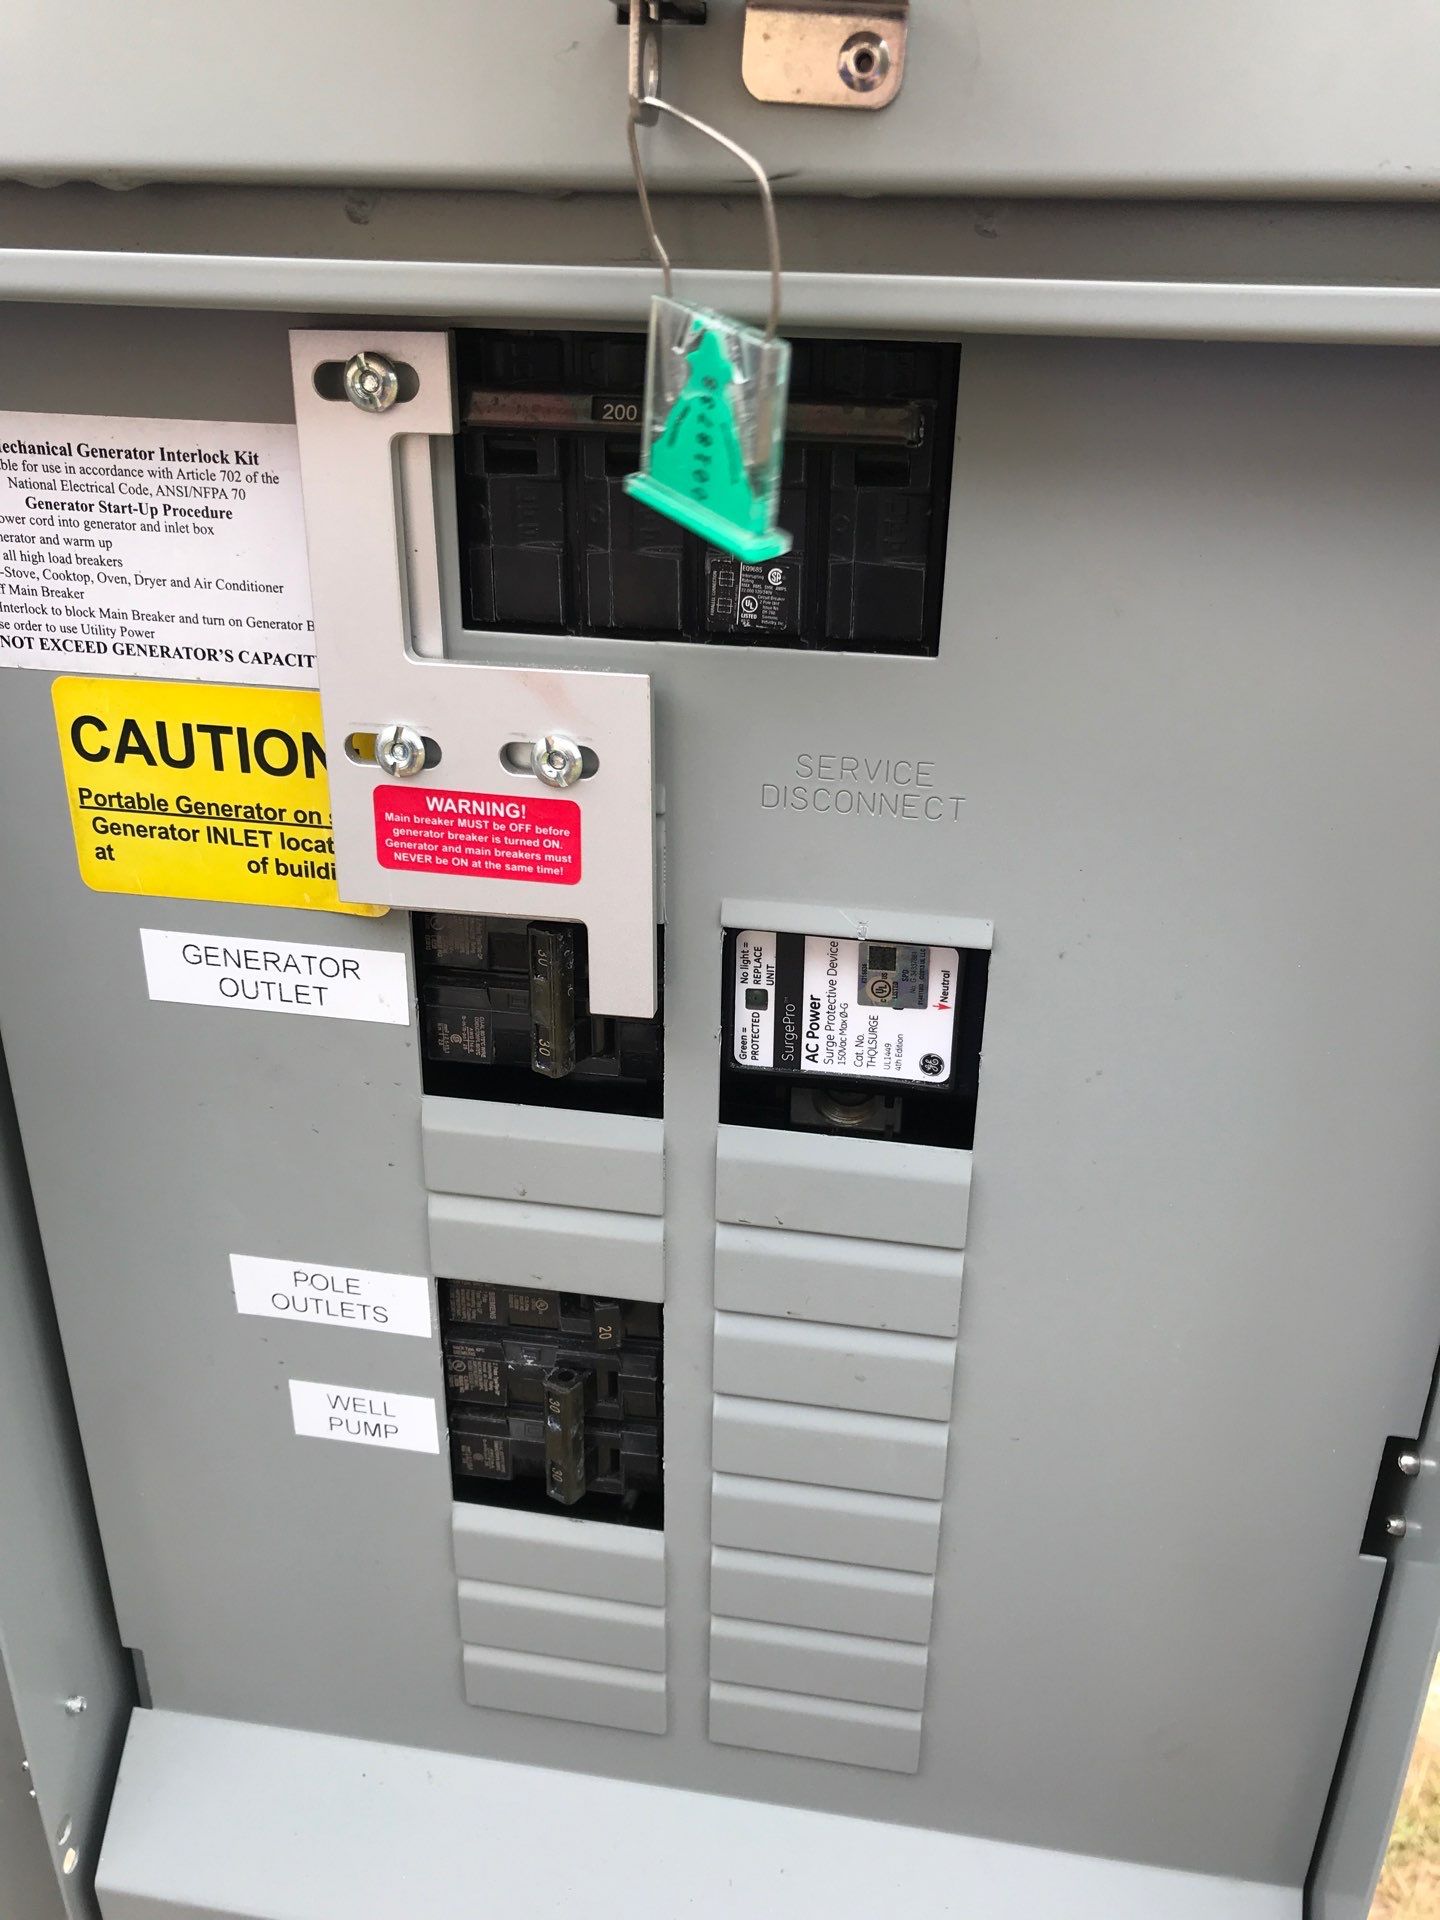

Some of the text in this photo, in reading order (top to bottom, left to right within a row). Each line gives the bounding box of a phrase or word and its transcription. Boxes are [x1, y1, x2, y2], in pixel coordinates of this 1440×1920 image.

[602, 403, 637, 421] 200
[0, 440, 259, 465] echanical Generator Interlock Kit
[22, 460, 279, 484] for use in accordance with Article 702 of the
[7, 477, 246, 500] National Electrical Code, ANSI/NFPA 70
[25, 496, 233, 519] Generator Start-Up Procedure
[30, 516, 215, 535] cord into generator and inlet box
[39, 534, 113, 551] and warm up
[3, 551, 123, 568] all high load breakers
[9, 584, 38, 596] Main
[41, 586, 85, 599] Breaker
[43, 569, 94, 585] Cooktop,
[97, 572, 131, 586] Oven,
[134, 574, 167, 588] Dryer
[170, 577, 191, 588] and
[194, 578, 213, 589] Air
[215, 579, 284, 594] Conditioner
[0, 602, 48, 615] Interlock
[51, 606, 62, 616] to
[65, 606, 96, 618] block
[99, 608, 128, 620] Main
[132, 610, 175, 623] Breaker
[179, 614, 199, 624] and
[202, 615, 225, 626] turn
[228, 619, 243, 627] on
[246, 616, 303, 631] Generator
[14, 620, 155, 639] order to use Utility Power
[0, 635, 34, 650] NOT
[39, 637, 108, 654] EXCEED
[238, 650, 317, 668] CAPACIT
[795, 753, 936, 788] SERVICE
[78, 787, 169, 813] Portable
[176, 795, 287, 822] Generator
[294, 807, 321, 824] on
[426, 796, 526, 819] WARNING!
[761, 783, 966, 822] DISCONNECT
[92, 817, 199, 842] Generator
[207, 825, 272, 849] INLET
[384, 812, 570, 836] Main breaker MUST be OFF before
[392, 828, 563, 849] generator breaker is turned ON.
[95, 844, 115, 861] at
[247, 857, 269, 875] of
[385, 838, 572, 864] Generator and main breakers must
[393, 852, 564, 876] NEVER be ON at the same time!
[182, 943, 361, 980] GENERATOR
[740, 949, 751, 970] light
[753, 946, 762, 985] REPLACE
[740, 971, 749, 984] No
[766, 964, 775, 986] UNIT
[940, 970, 950, 1003] Neutral
[219, 977, 328, 1007] OUTLET
[824, 940, 839, 1064] Surge Protective Device
[751, 1011, 760, 1061] PROTECTED
[805, 994, 821, 1063] AC Power
[539, 1039, 550, 1057] 30
[739, 1036, 748, 1060] Green
[838, 1019, 848, 1065] 150Vac Max
[854, 1033, 864, 1067] Cat. No.
[867, 1015, 878, 1068] THQLSURGE
[293, 1271, 361, 1295] POLE
[271, 1293, 389, 1323] OUTLETS
[599, 1326, 612, 1340] 20
[326, 1393, 397, 1418] WELL
[549, 1398, 561, 1414] 30
[328, 1417, 399, 1438] PUMP
[552, 1467, 563, 1483] 30
